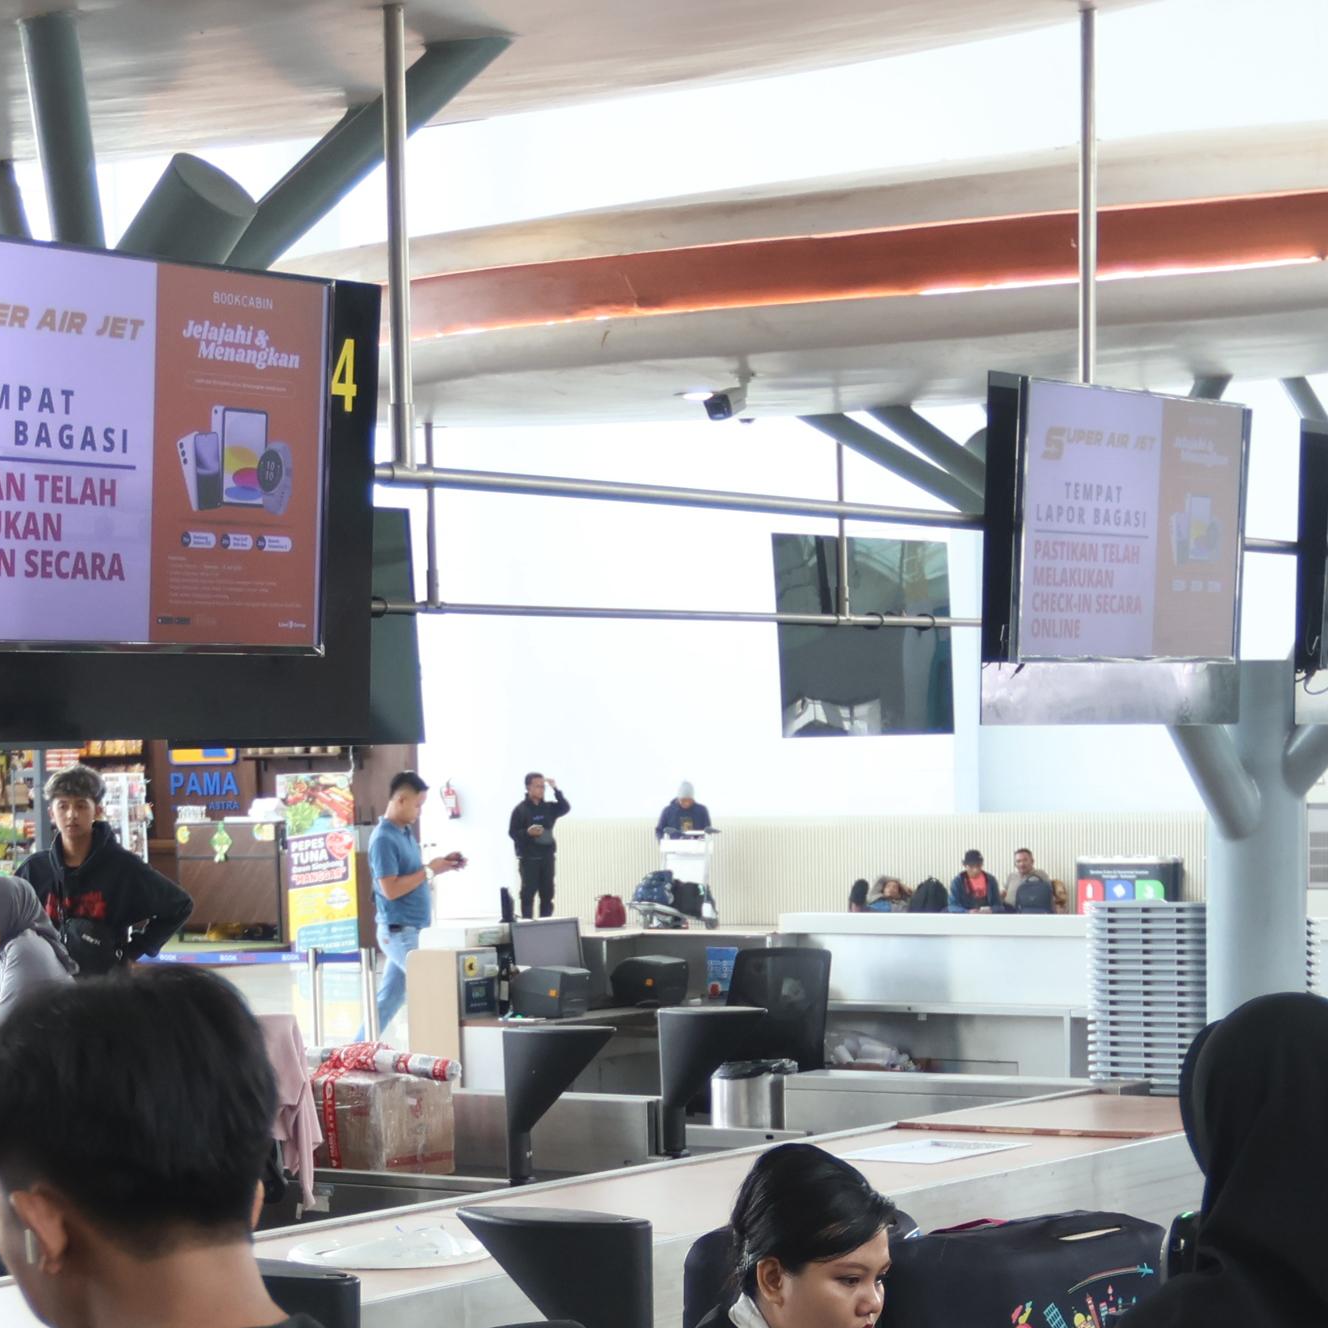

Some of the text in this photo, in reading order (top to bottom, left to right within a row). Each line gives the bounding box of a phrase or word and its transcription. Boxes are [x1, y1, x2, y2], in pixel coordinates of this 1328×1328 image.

[213, 290, 274, 310] BOOKCABIN
[36, 308, 88, 336] AIR
[96, 315, 145, 341] JET
[182, 319, 254, 346] Jelajahi
[197, 340, 301, 370] Menangkan
[331, 338, 358, 413] 4
[14, 421, 129, 455] BAGASI
[34, 474, 117, 508] TELAH
[1065, 481, 1124, 504] TEMPAT
[1036, 503, 1147, 529] LAPOR BAGASI
[1034, 540, 1141, 565] PASTIKAN TELAH
[24, 549, 126, 582] SECARA
[1033, 566, 1115, 589] MELAKUKAN
[1032, 592, 1143, 616] CHECK-IN SECARA
[1031, 618, 1082, 640] ONLINE
[170, 771, 240, 796] PAMA
[291, 836, 326, 853] PEPES
[291, 849, 329, 866] TUNA
